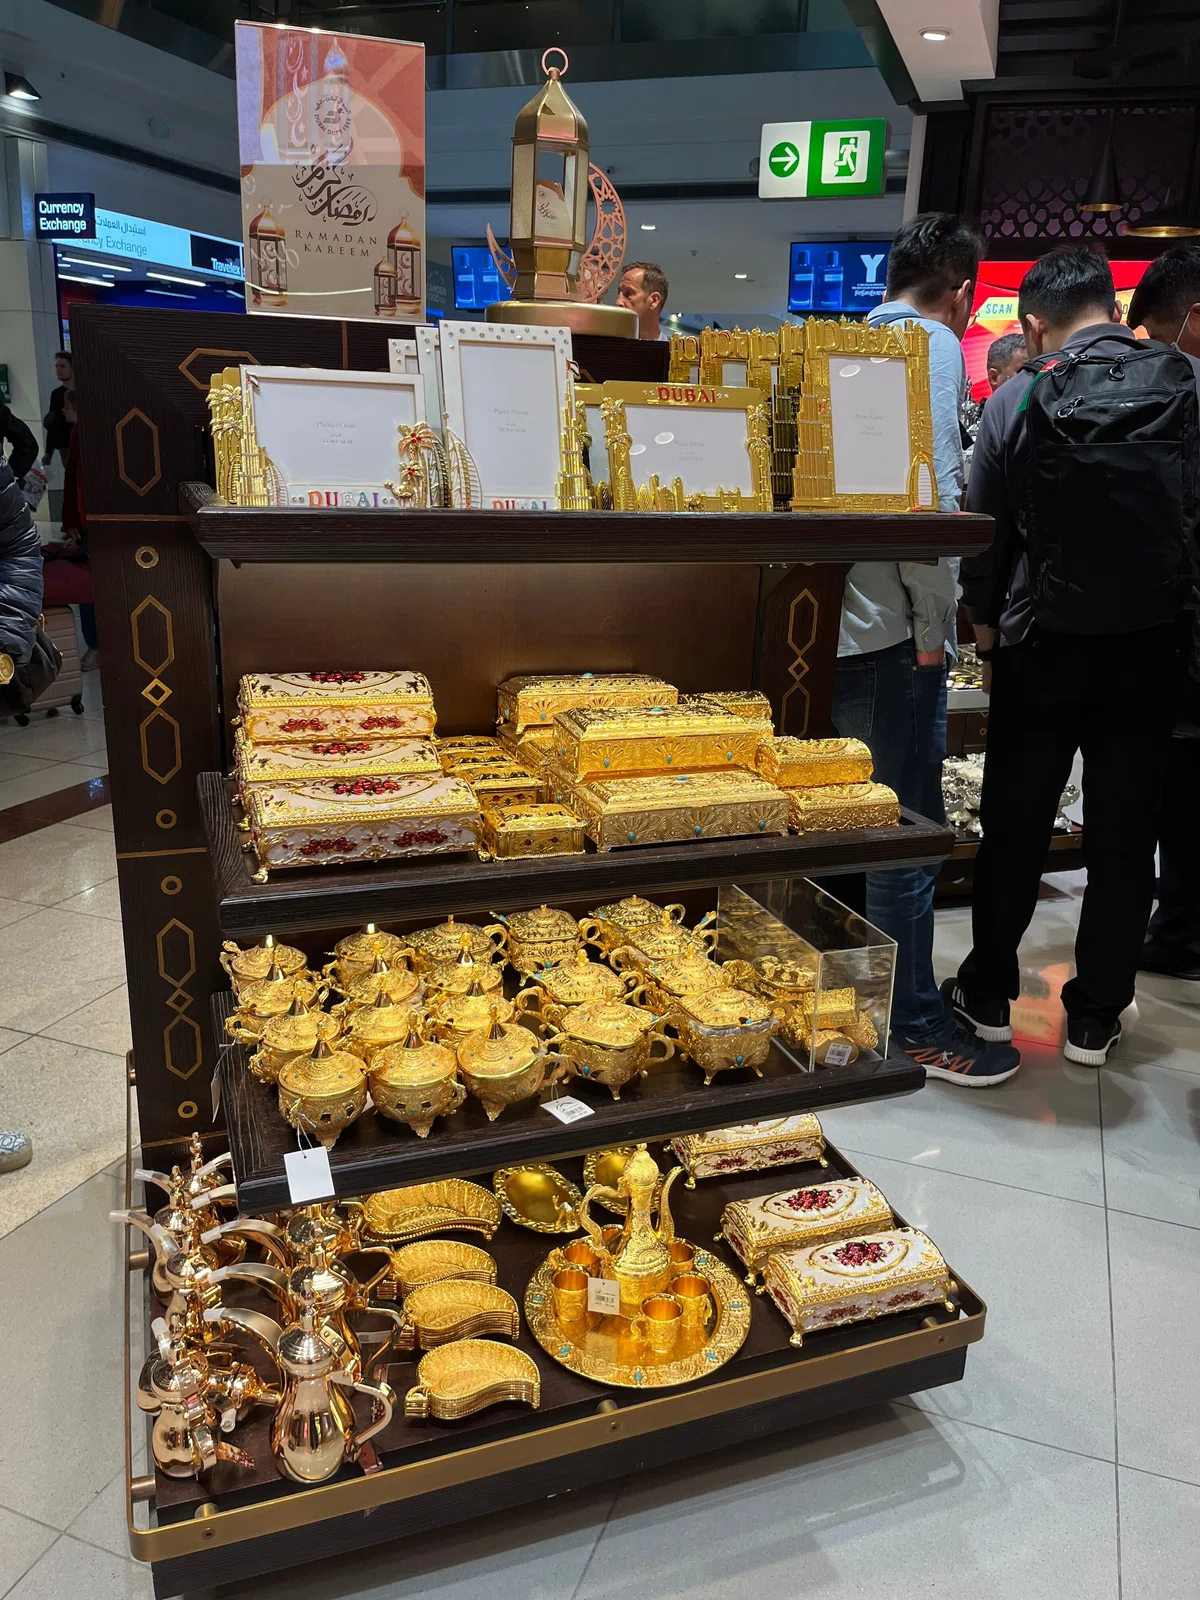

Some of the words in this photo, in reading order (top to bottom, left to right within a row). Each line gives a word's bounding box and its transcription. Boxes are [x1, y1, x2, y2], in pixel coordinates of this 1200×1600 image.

[314, 114, 327, 132] DUBAI
[39, 200, 84, 216] Currency
[40, 217, 87, 233] Exchange
[106, 235, 147, 257] Exchange
[295, 230, 377, 245] RAMADAN
[304, 243, 370, 257] KAREEM
[211, 257, 241, 275] Travelex
[860, 254, 885, 282] Y
[986, 303, 1013, 315] SCAN
[657, 386, 717, 403] DUBAI
[308, 490, 379, 508] DUBAI
